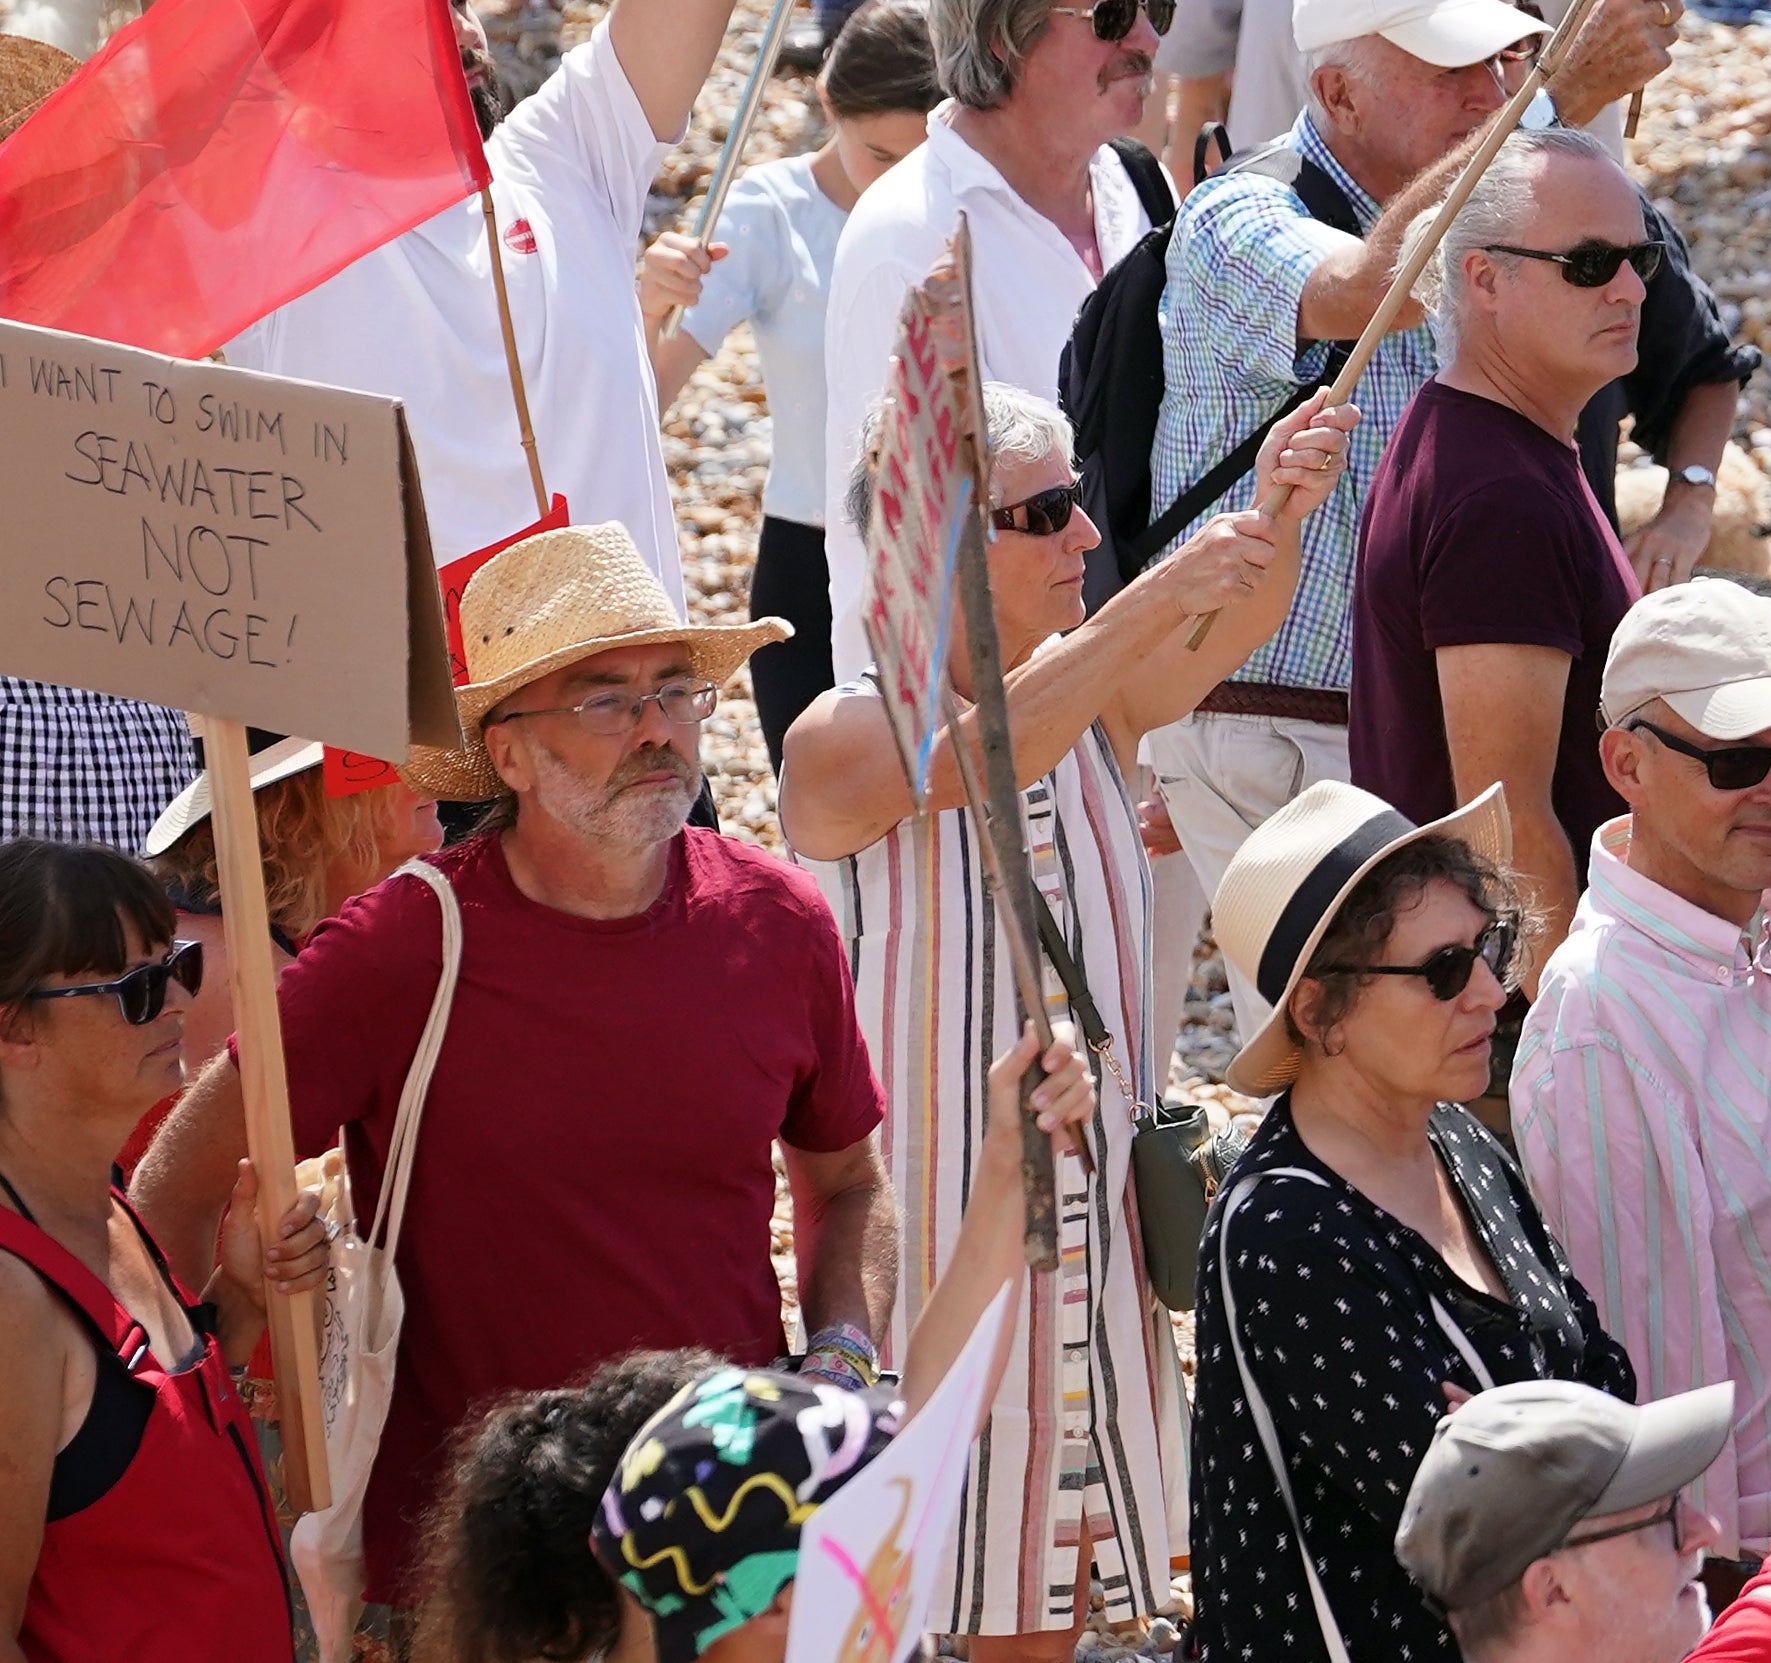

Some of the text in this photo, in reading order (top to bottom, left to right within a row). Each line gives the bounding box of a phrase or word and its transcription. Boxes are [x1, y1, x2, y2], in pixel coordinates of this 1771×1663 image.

[29, 356, 122, 404] WANT
[142, 382, 176, 424] TO
[196, 394, 287, 455] SWIM
[314, 423, 348, 465] IN
[65, 431, 322, 533] SEAWATER
[141, 516, 270, 600] NOT
[43, 576, 297, 668] SEWAGE!
